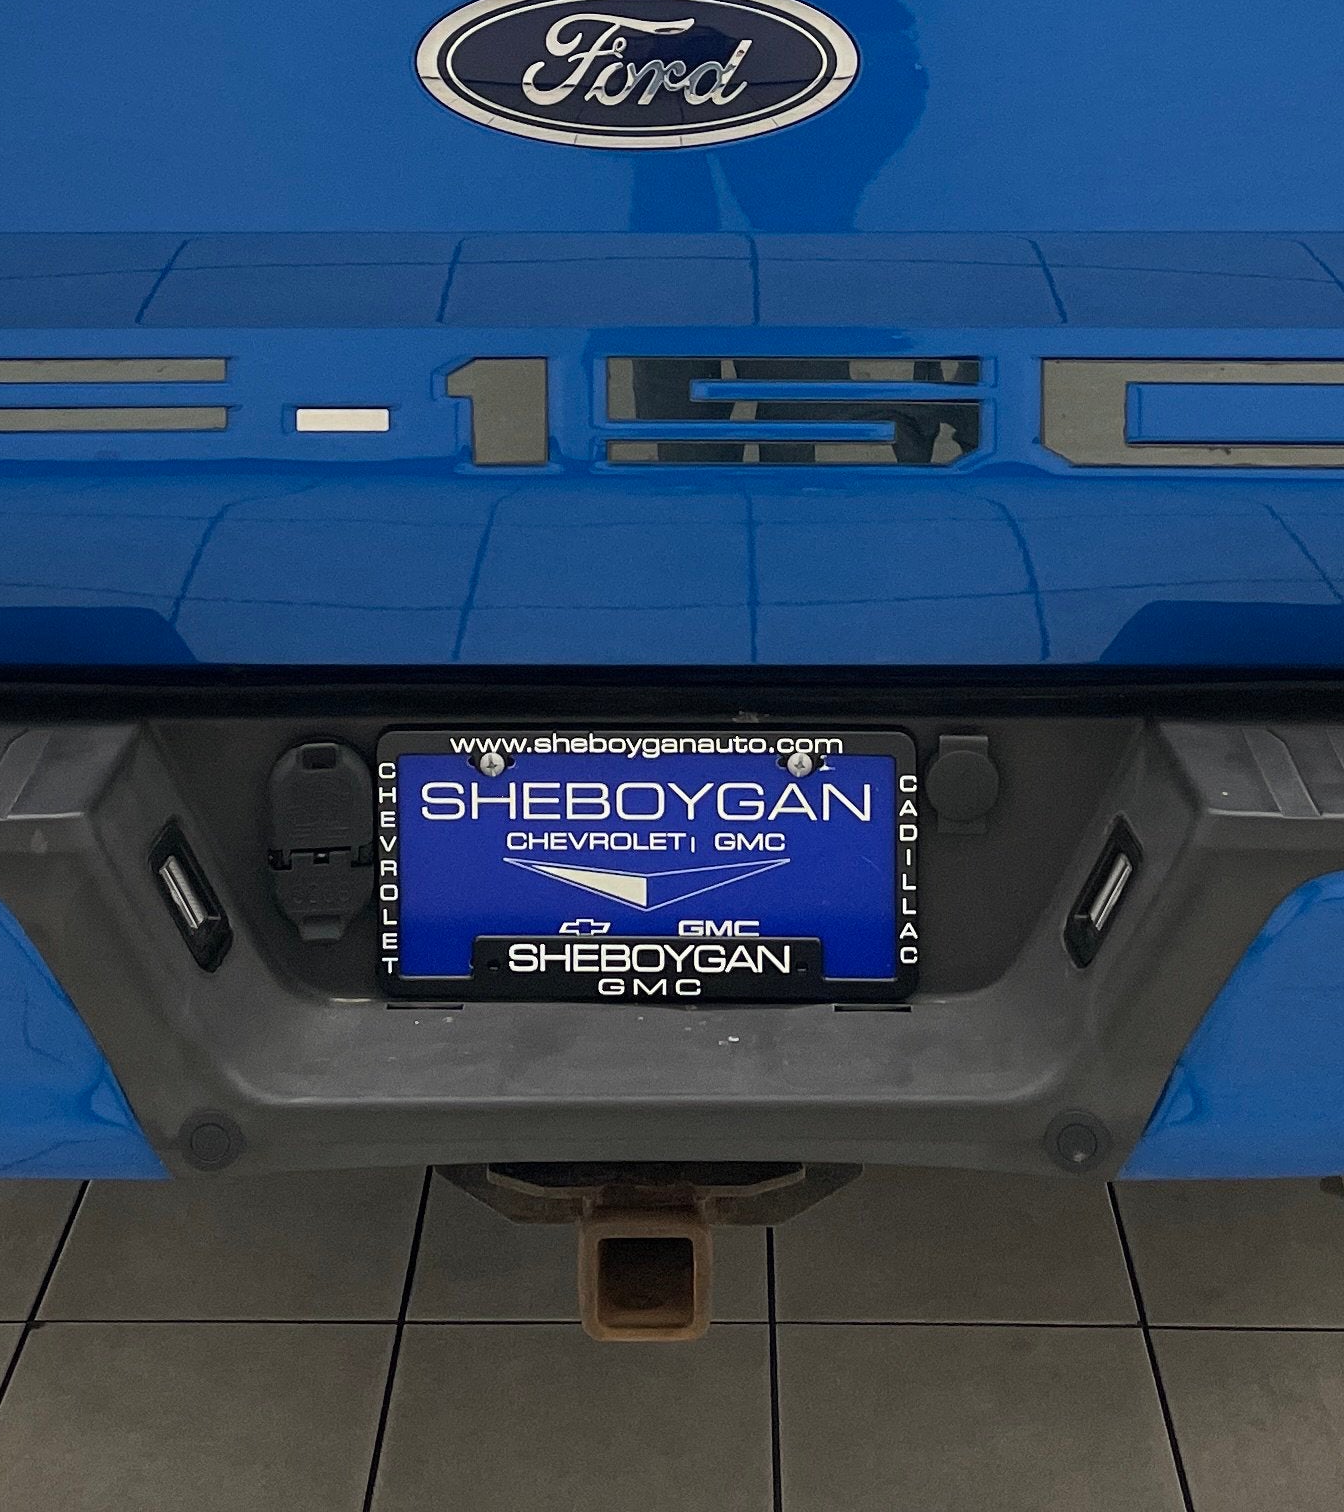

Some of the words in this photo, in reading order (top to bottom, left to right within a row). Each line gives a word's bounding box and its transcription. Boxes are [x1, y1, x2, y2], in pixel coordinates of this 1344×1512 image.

[522, 12, 753, 106] Ford
[450, 733, 844, 759] www.sheboyganauto.com
[420, 782, 872, 822] SHEBOYGAN
[506, 832, 690, 852] CHEVROLET
[714, 832, 787, 852] GMC
[377, 762, 399, 976] CHEVROLET
[899, 774, 919, 965] CADILLAC
[677, 919, 761, 937] GMC
[507, 943, 791, 975] SHEBOYGAN
[597, 978, 703, 997] GMC
